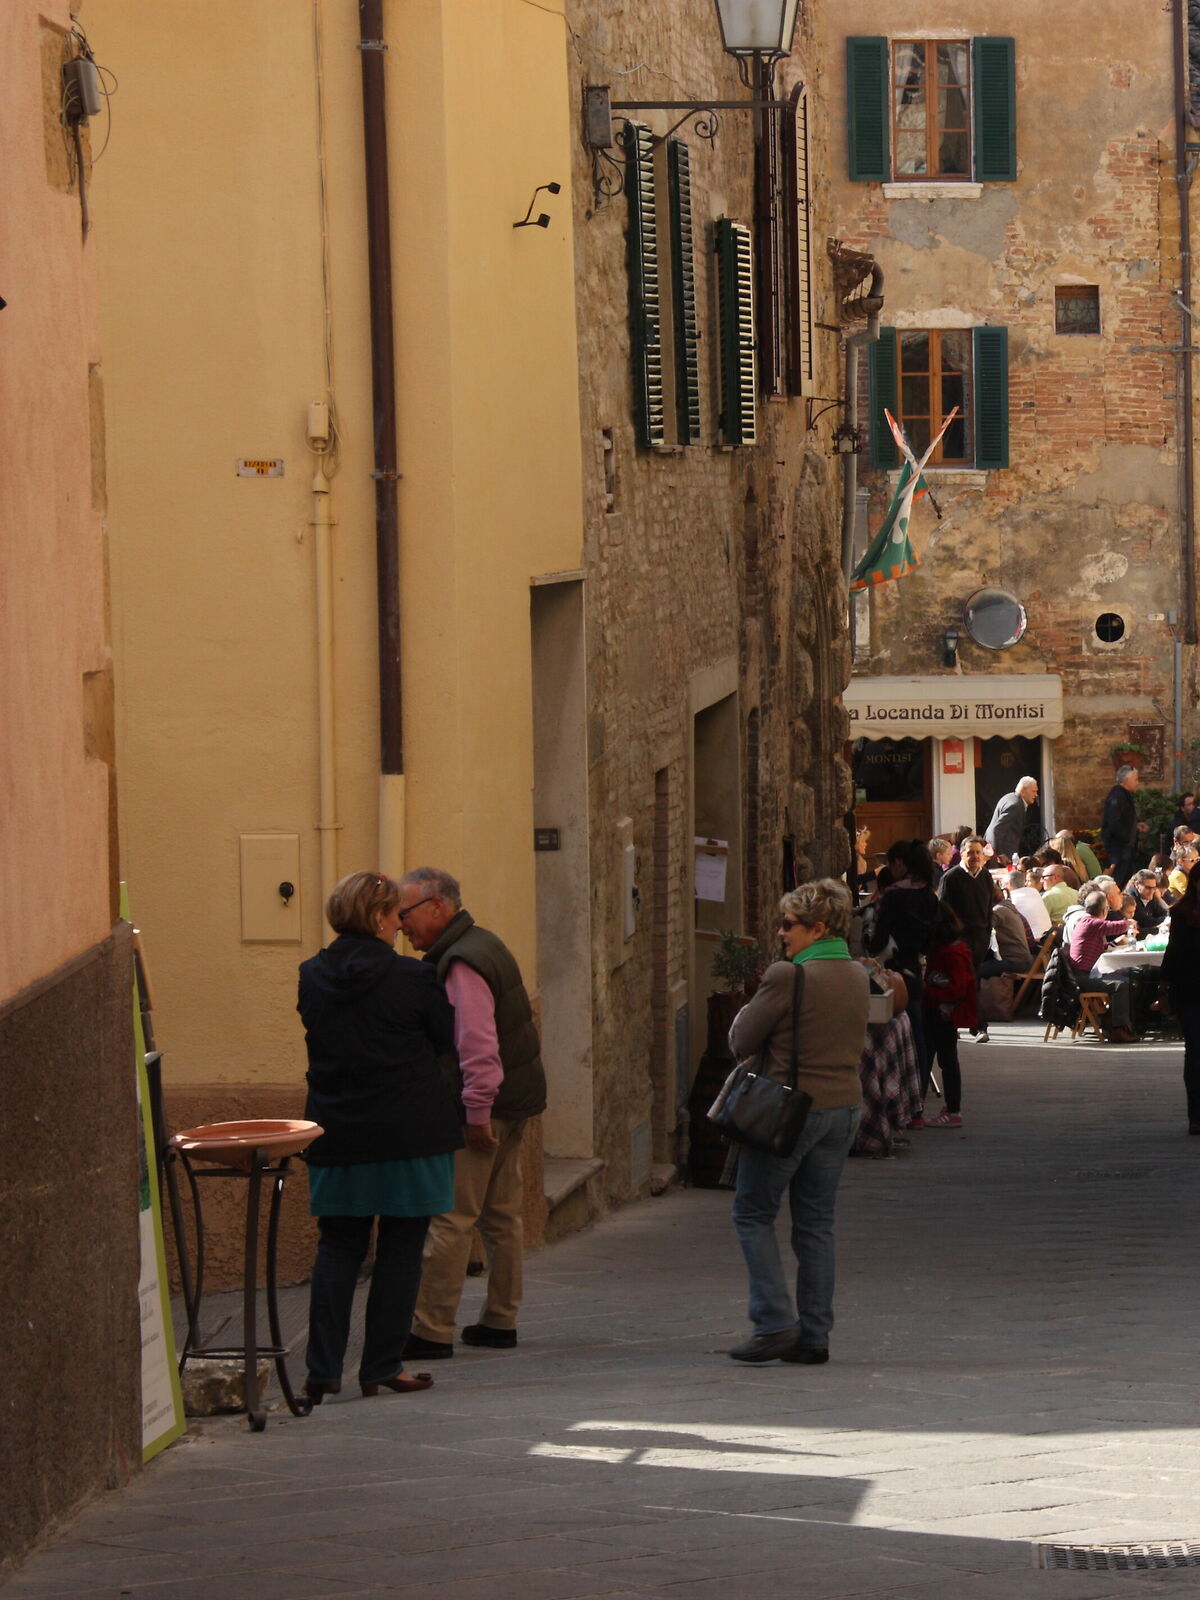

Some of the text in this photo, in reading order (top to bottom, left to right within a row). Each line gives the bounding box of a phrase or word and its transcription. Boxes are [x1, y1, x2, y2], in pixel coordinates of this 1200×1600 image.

[848, 703, 1045, 721] a Locanda Di Montisi
[865, 752, 913, 764] MONTISI
